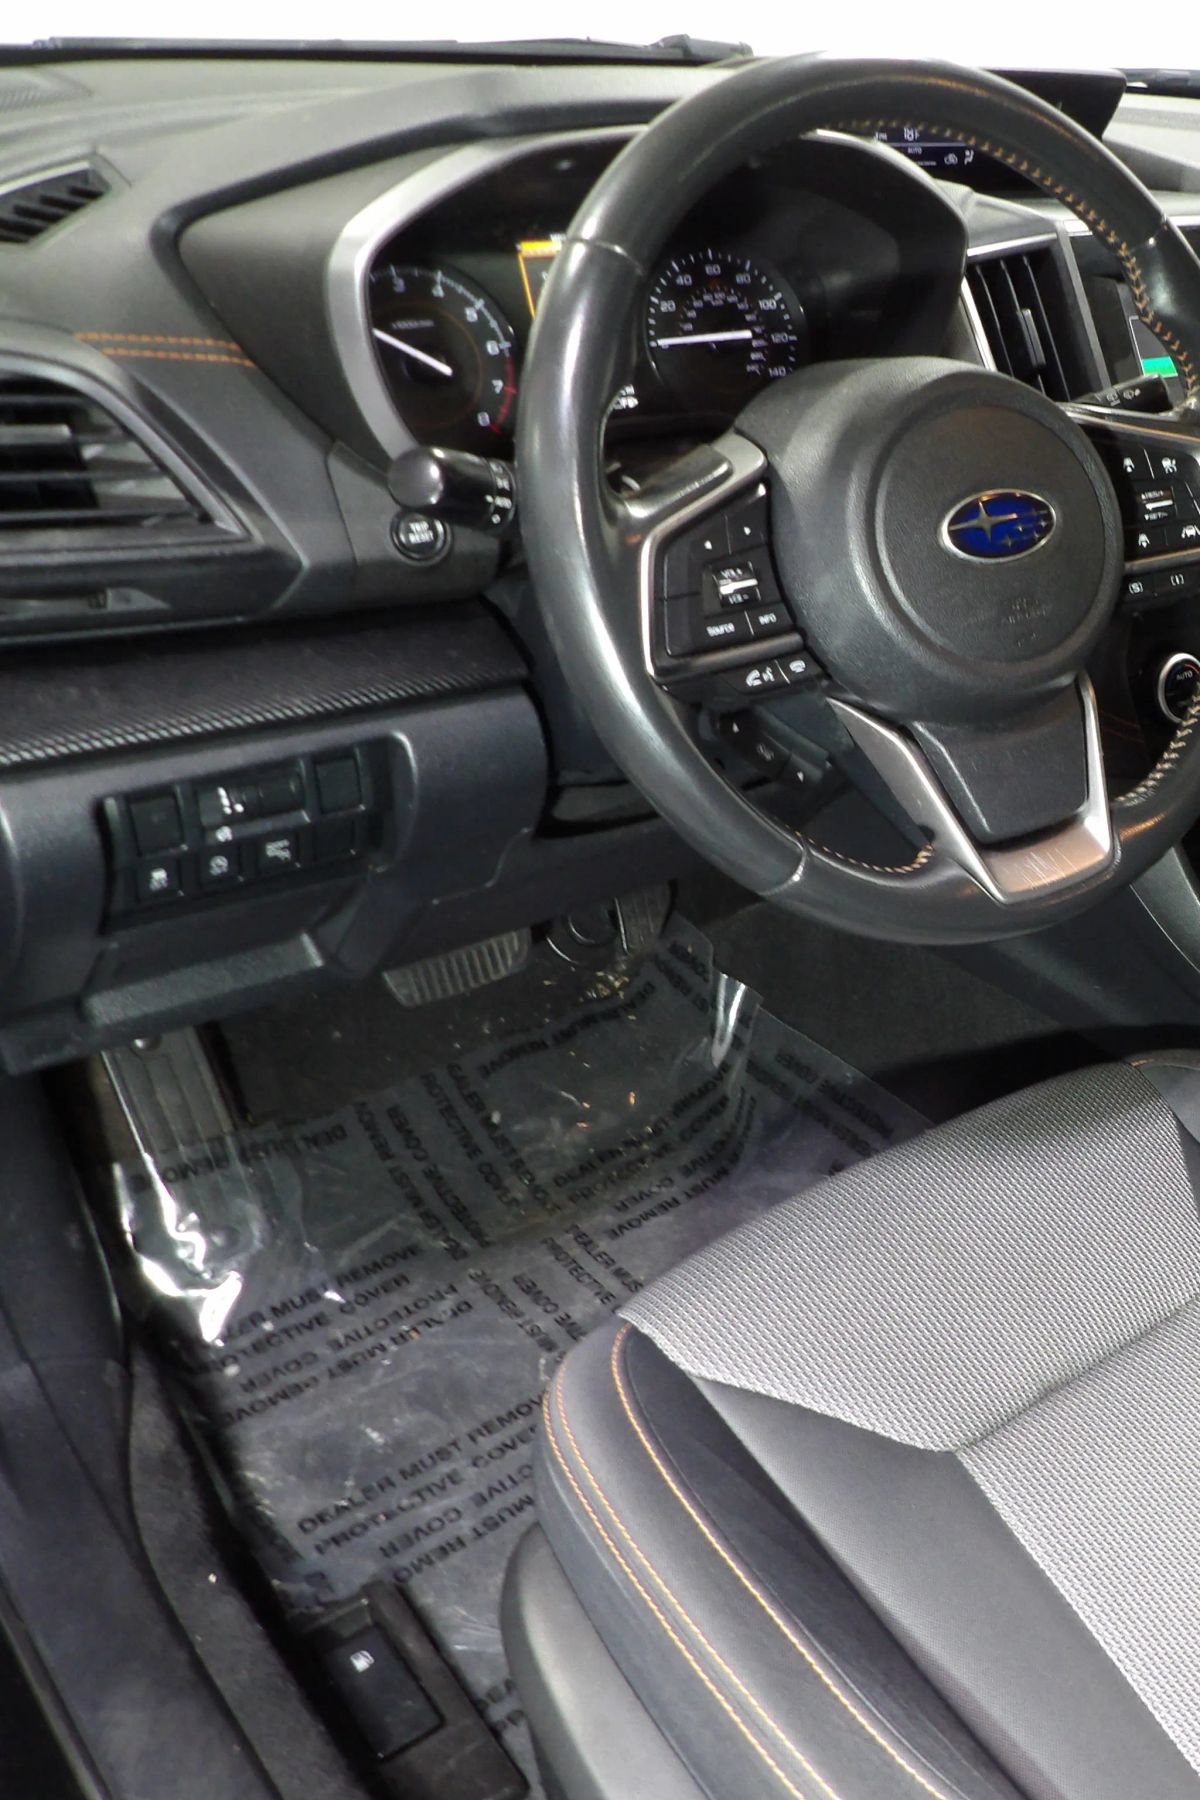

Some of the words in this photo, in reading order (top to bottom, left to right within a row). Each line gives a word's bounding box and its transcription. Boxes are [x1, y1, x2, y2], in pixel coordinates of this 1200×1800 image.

[676, 275, 692, 286] 40
[660, 301, 676, 312] 20
[758, 299, 777, 312] 100
[771, 333, 788, 344] 120
[768, 367, 786, 377] 140
[758, 612, 777, 625] INFO
[1176, 670, 1193, 681] AUTO
[607, 1196, 680, 1240] REMOVE
[339, 1273, 412, 1316] COVER
[326, 1283, 459, 1352] PROTECTIVE
[239, 1351, 319, 1394] COVER
[297, 1475, 396, 1535] DEALER
[399, 1439, 463, 1482] MUST
[313, 1467, 465, 1555] PROTECTIVE
[378, 1506, 463, 1559] COVER
[471, 1493, 535, 1541] MUST
